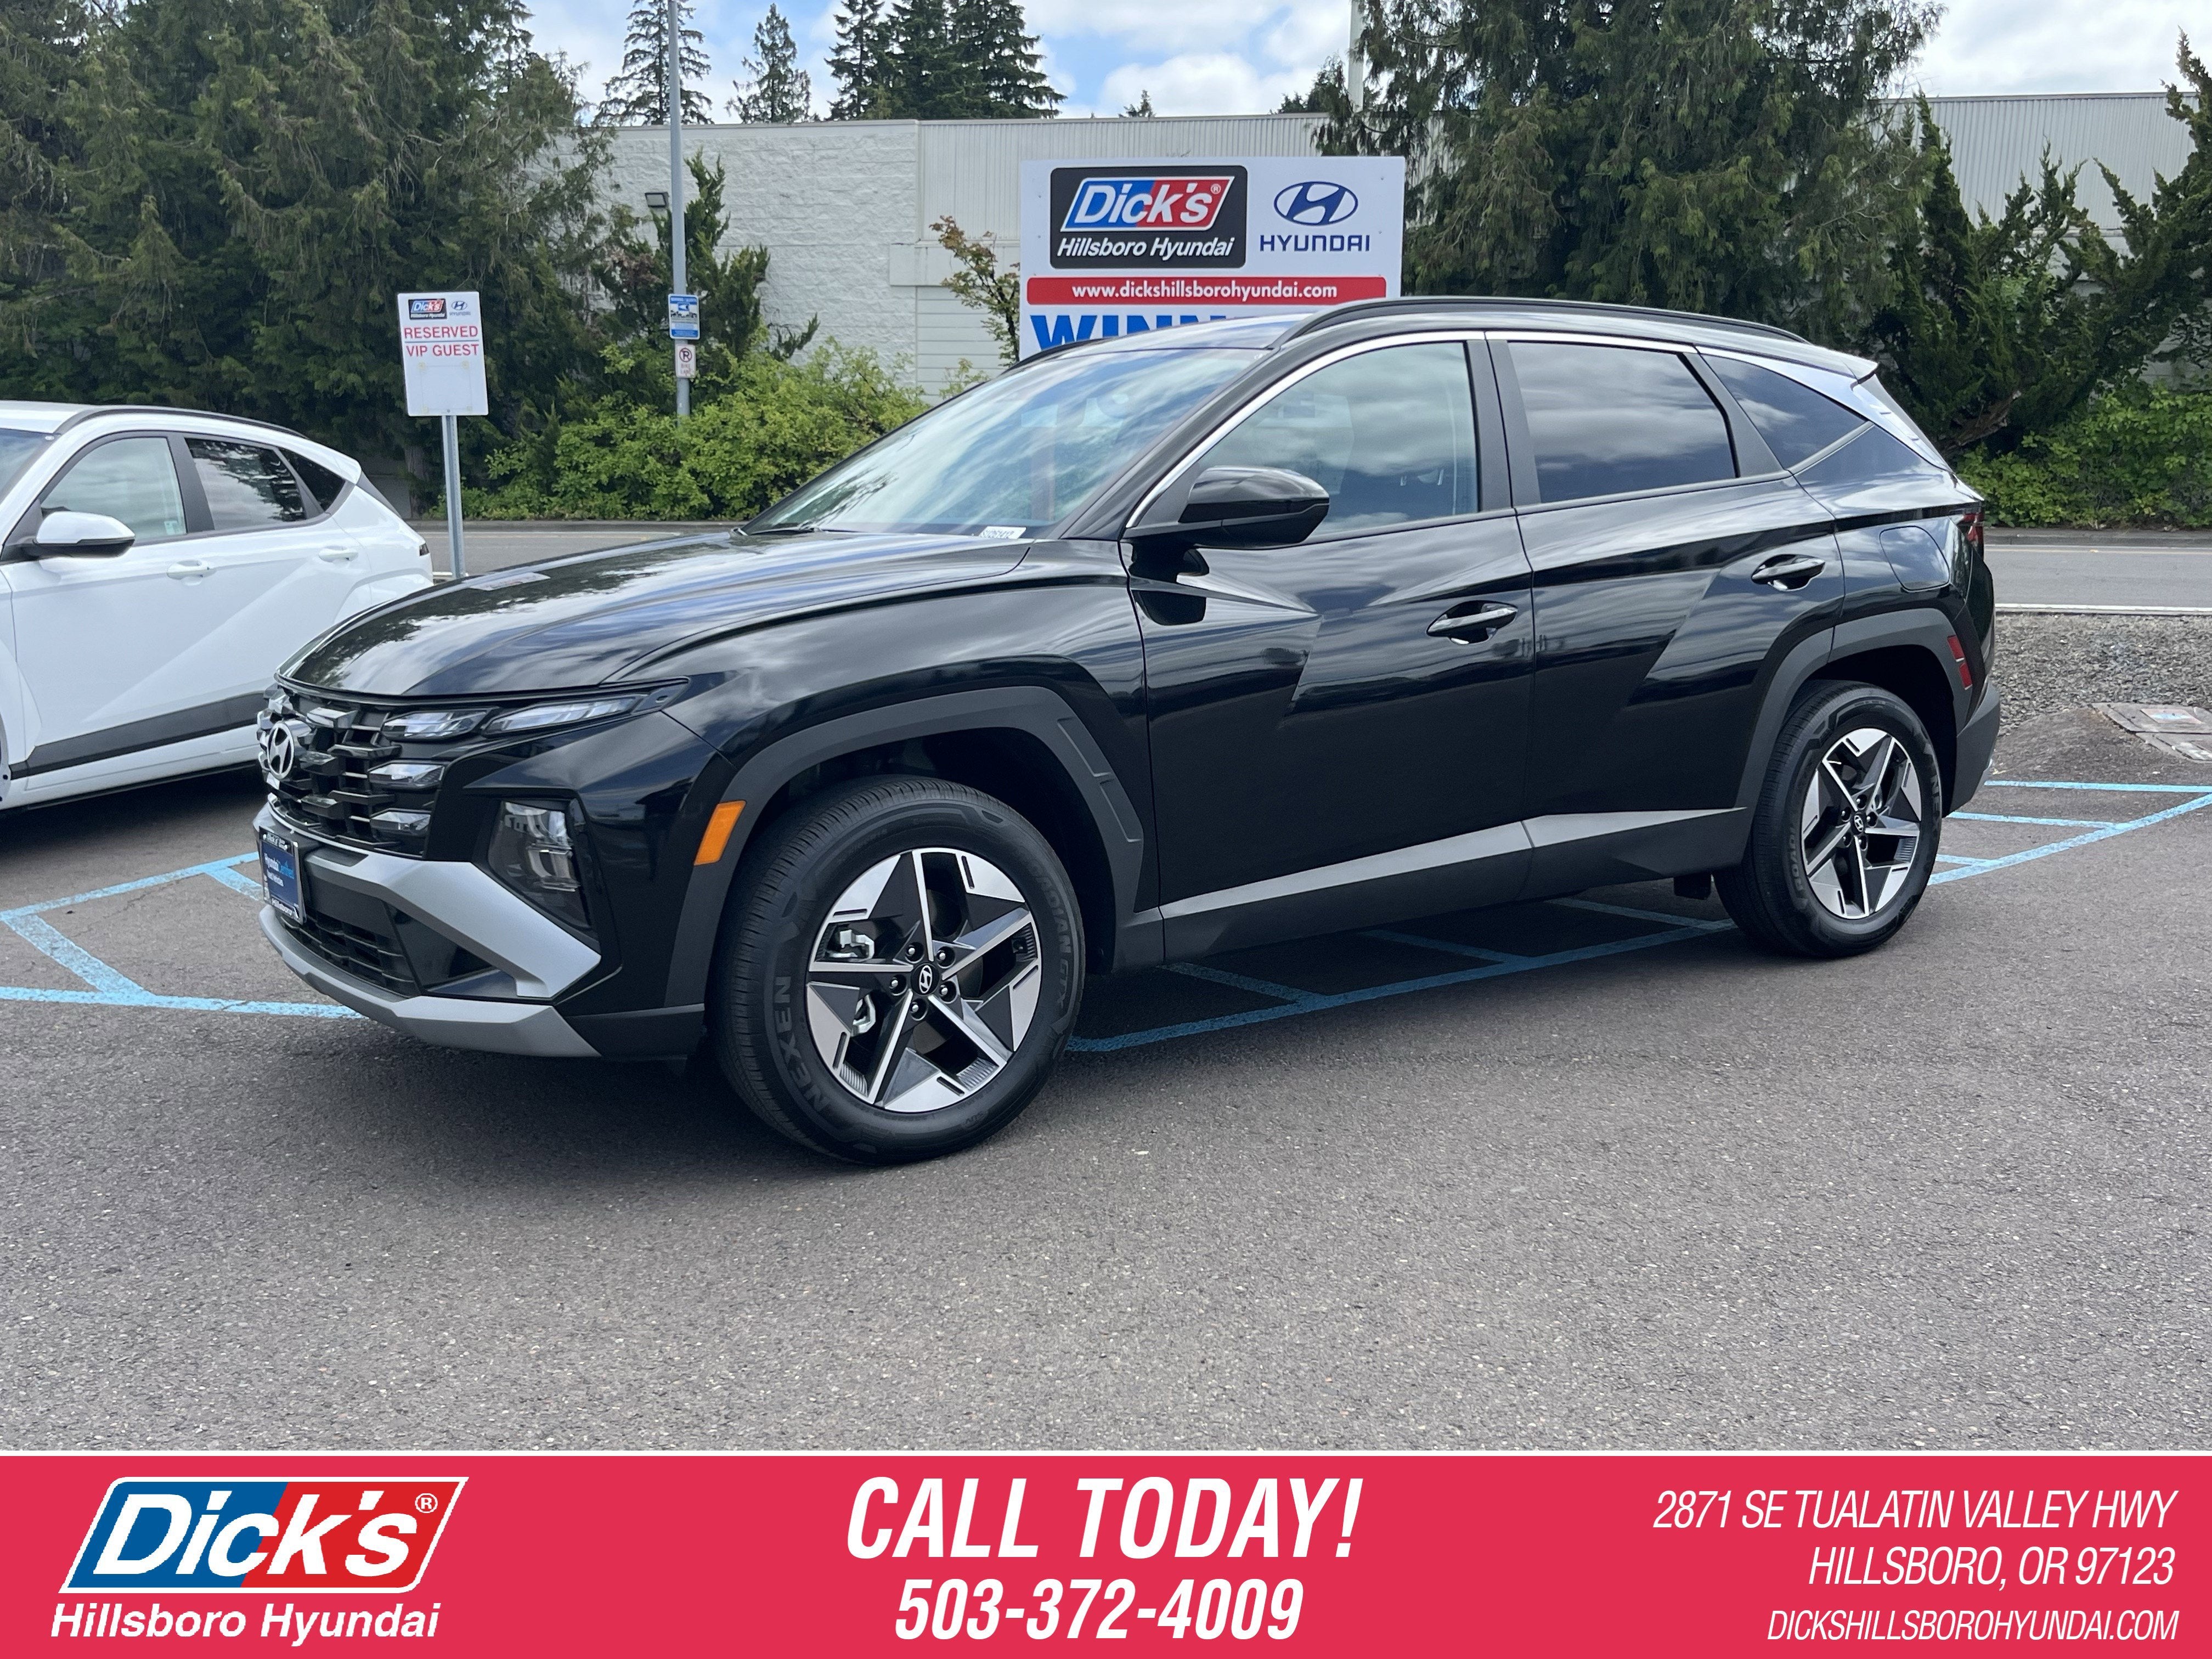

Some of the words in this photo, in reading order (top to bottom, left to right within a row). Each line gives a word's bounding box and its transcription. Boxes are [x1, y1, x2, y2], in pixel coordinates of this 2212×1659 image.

[1057, 236, 1147, 257] Hillsboro
[1150, 236, 1235, 261] Hyundai
[1260, 235, 1370, 251] HYUNDAI
[1071, 280, 1338, 303] www.dickshillsborohyundai.com
[404, 325, 478, 338] RESERVED
[406, 345, 427, 357] VIP
[432, 344, 479, 357] GUEST
[774, 975, 829, 1113] NEXEN
